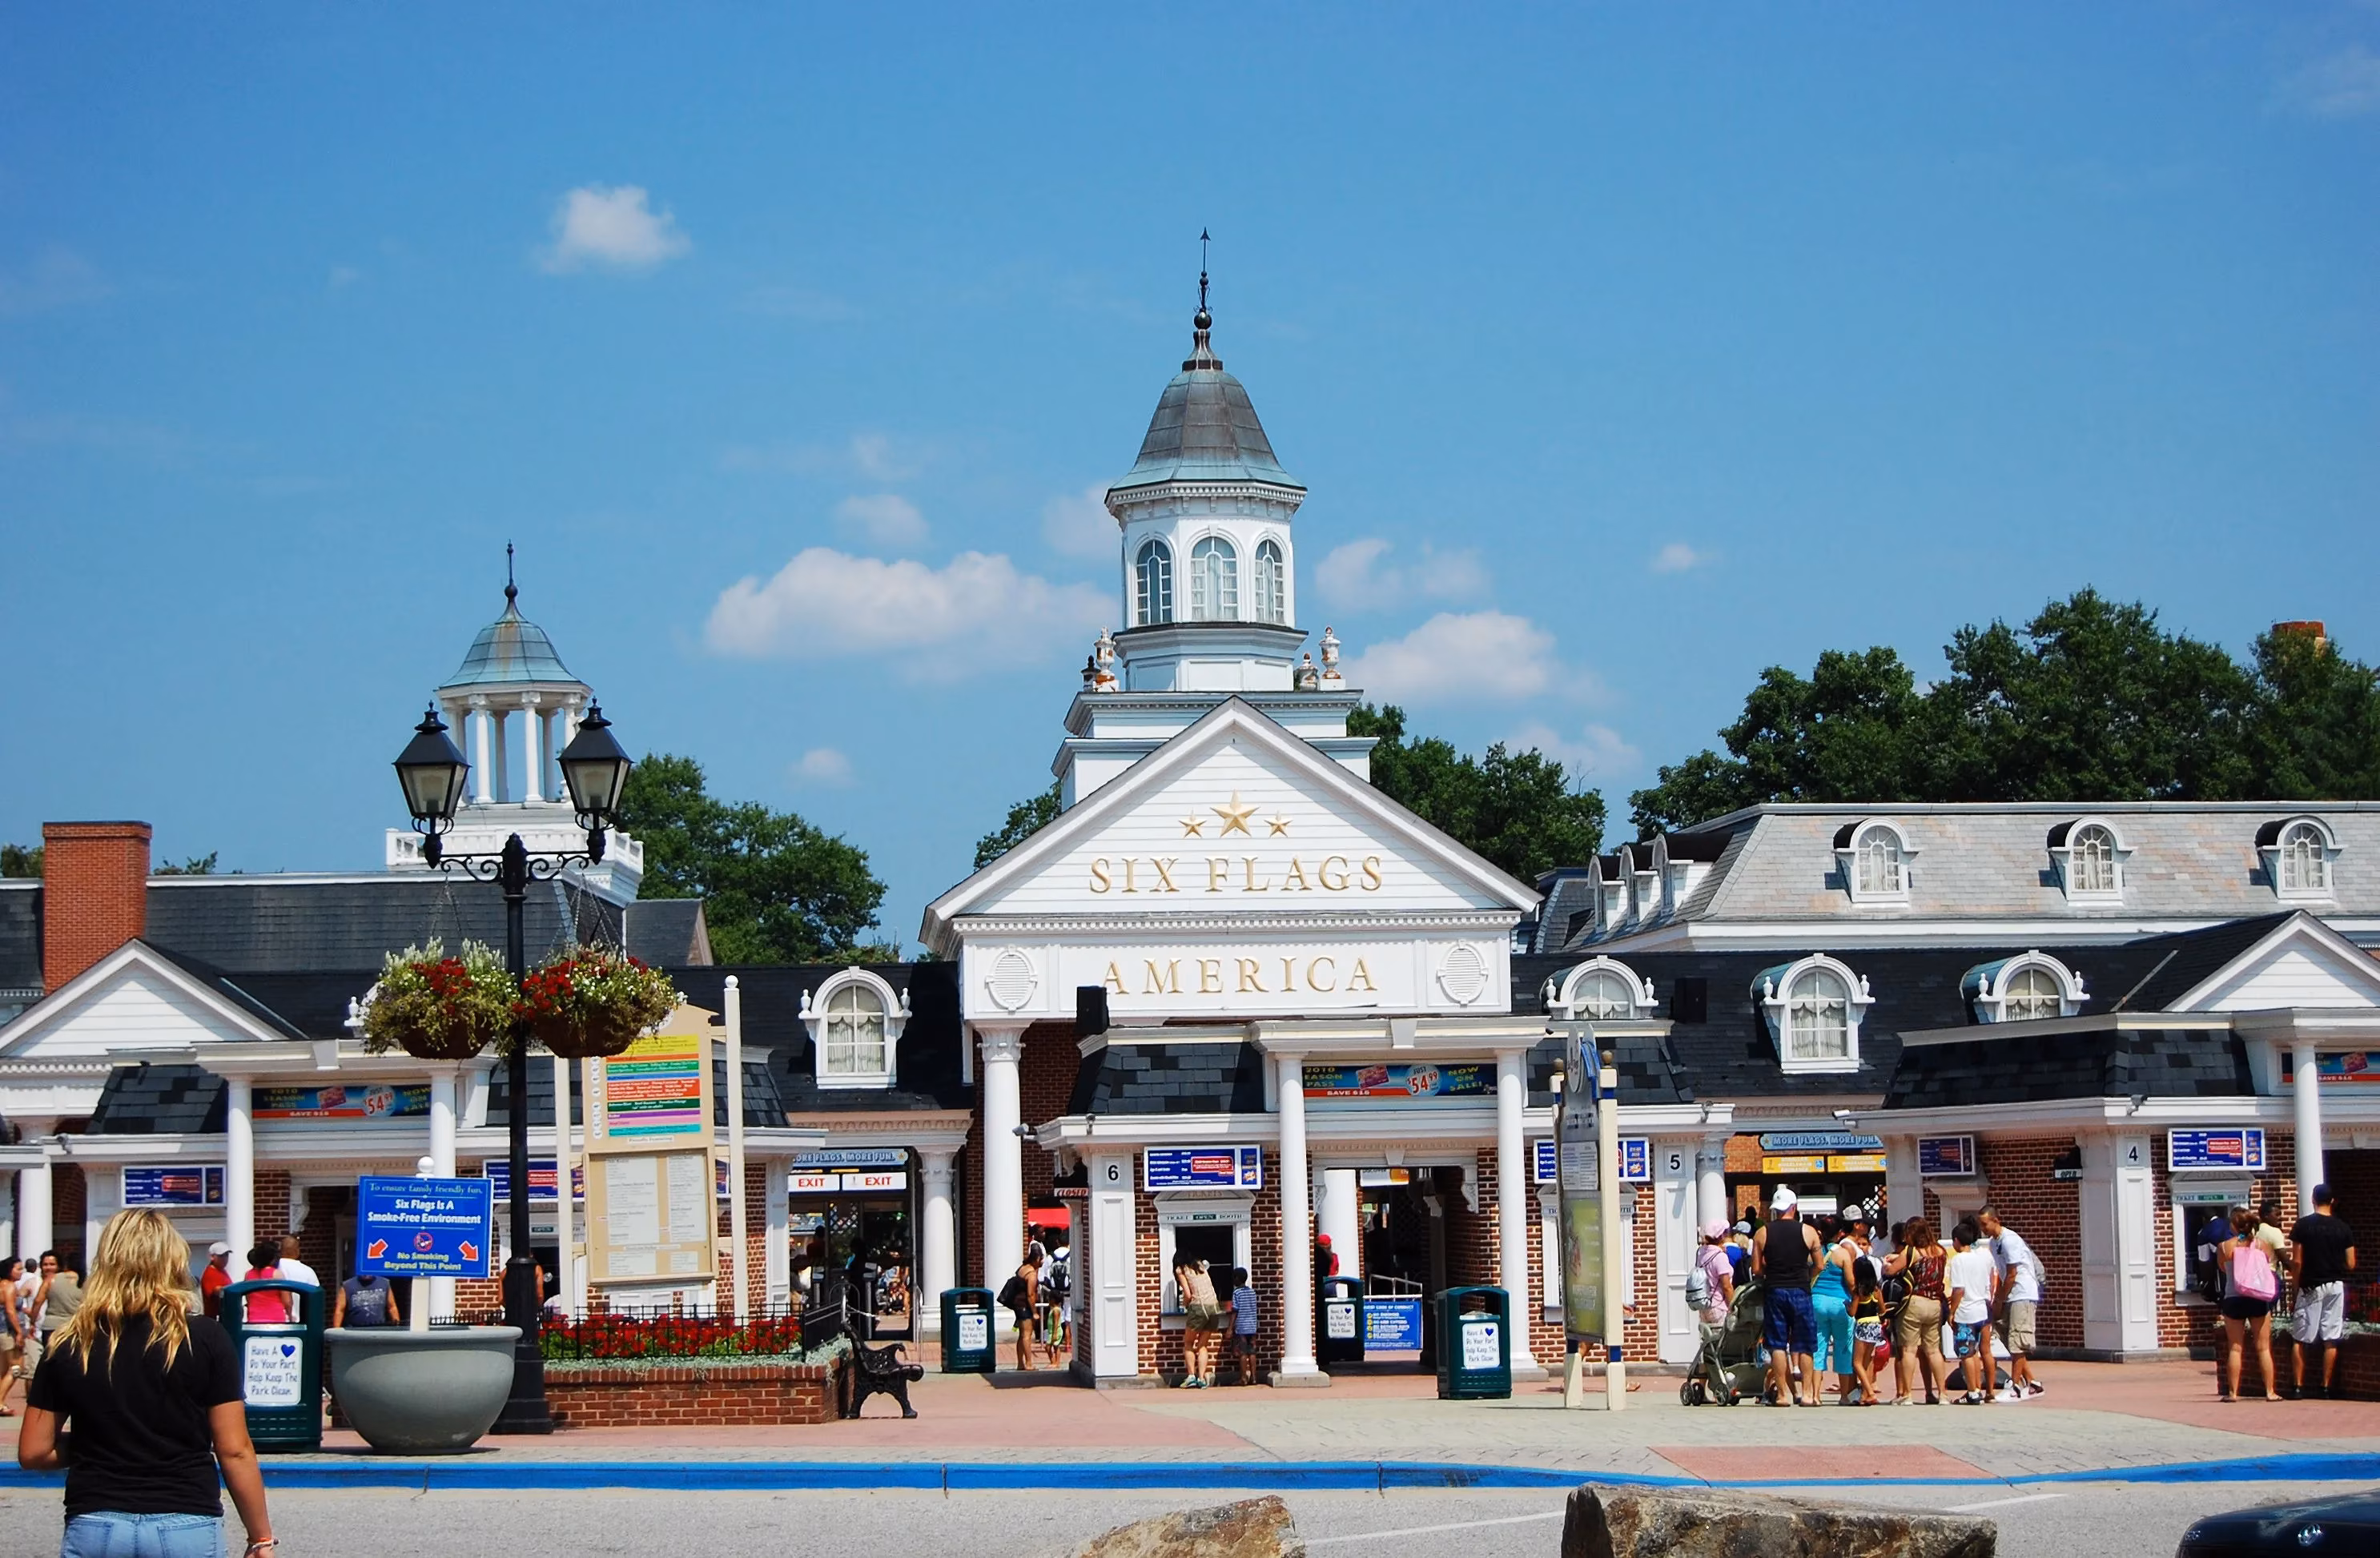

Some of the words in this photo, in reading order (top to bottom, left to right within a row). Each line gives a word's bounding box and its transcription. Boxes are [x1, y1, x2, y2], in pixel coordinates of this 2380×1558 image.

[1089, 857, 1180, 893] SIX
[1204, 854, 1383, 892] FLAGS
[1104, 956, 1378, 994] AMERICA
[1413, 1066, 1427, 1075] JUST
[1448, 1066, 1479, 1077] NOW
[1456, 1074, 1474, 1082] ON
[1773, 1136, 1799, 1146] MORE
[1831, 1135, 1855, 1145] MORE
[794, 1153, 814, 1162] ORE
[846, 1152, 873, 1162] MORE
[2128, 1146, 2138, 1162] 4
[1670, 1154, 1680, 1170] 5
[1108, 1165, 1120, 1181] 6
[798, 1179, 825, 1187] EXIT
[865, 1177, 891, 1186] EXIT
[370, 1183, 380, 1191] To
[409, 1183, 432, 1195] family
[436, 1183, 465, 1195] friendly
[396, 1199, 409, 1209] Six
[411, 1199, 436, 1211] Flags
[437, 1200, 444, 1210] Is
[446, 1201, 454, 1210] A
[368, 1211, 420, 1223] Smoke-Free
[422, 1214, 481, 1224] Environment
[412, 1252, 449, 1263] Smoking
[384, 1262, 417, 1271] Beyond
[419, 1262, 436, 1270] This
[438, 1263, 461, 1271] Point
[251, 1346, 269, 1355] Have
[272, 1346, 278, 1355] A
[250, 1359, 258, 1369] Do
[262, 1359, 277, 1369] Your
[249, 1372, 263, 1383] Help
[266, 1372, 283, 1383] Keep
[285, 1372, 298, 1383] The
[251, 1385, 269, 1395] Park
